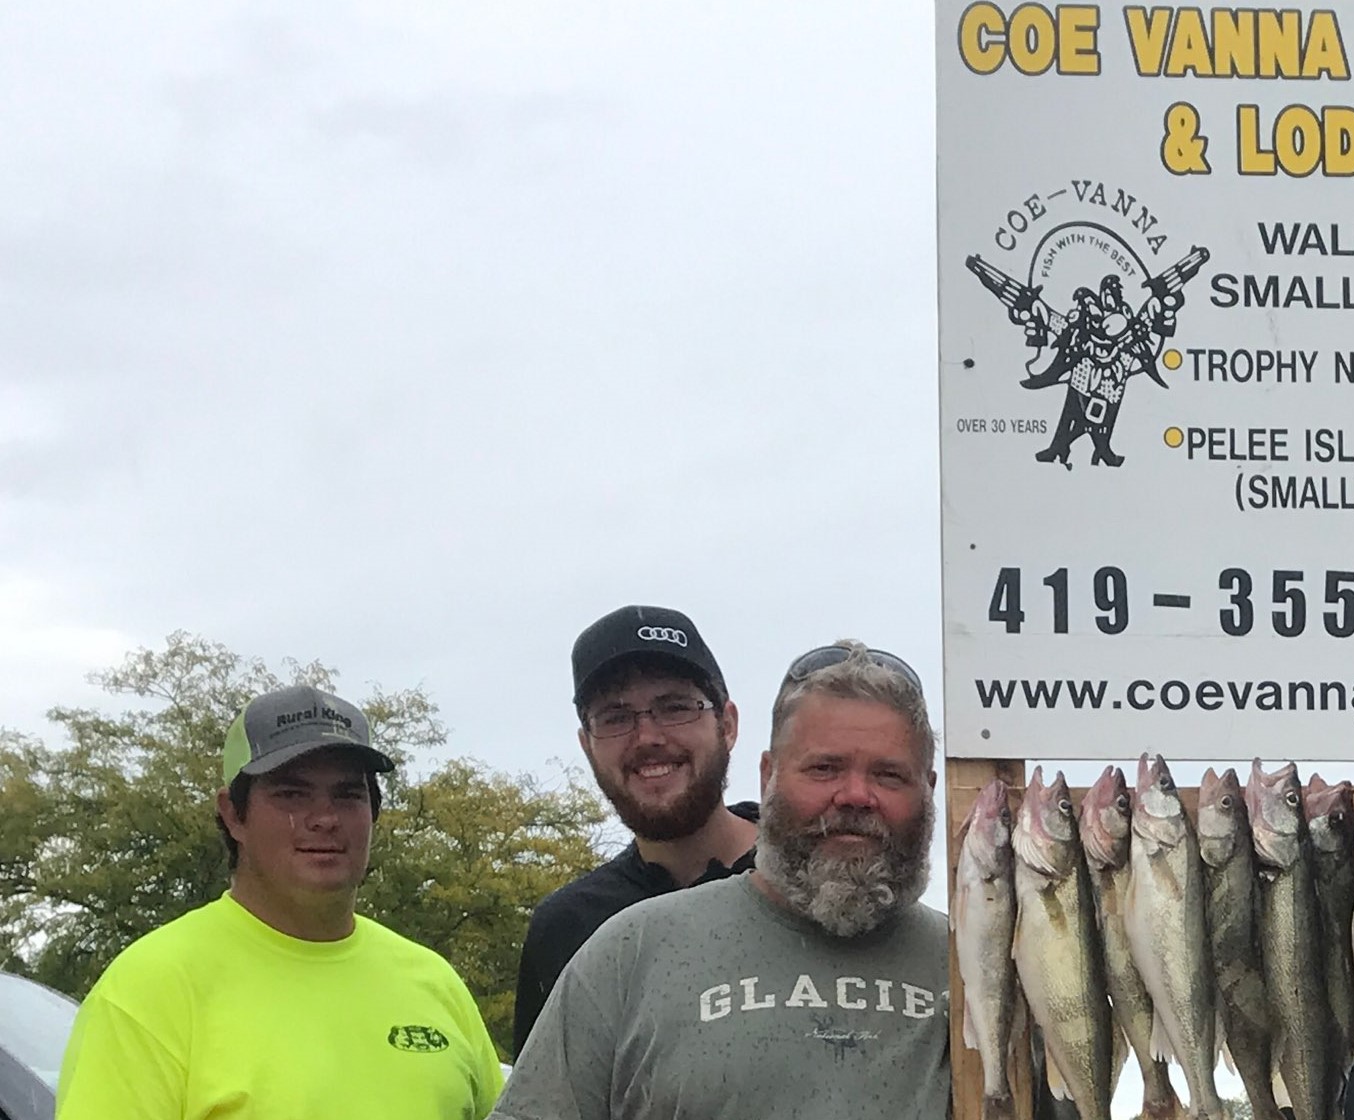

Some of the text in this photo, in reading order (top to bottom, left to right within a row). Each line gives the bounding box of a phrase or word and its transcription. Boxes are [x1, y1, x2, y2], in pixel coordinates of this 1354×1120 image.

[957, 1, 1102, 77] COE
[1122, 5, 1352, 82] VANNA
[1159, 101, 1212, 177] &
[994, 179, 1169, 256] COE-VANNA
[1041, 233, 1137, 278] FISH WITH THE BEST
[1186, 348, 1319, 384] TROPHY
[956, 418, 1047, 434] OVER 30 YEARS
[1187, 427, 1289, 462] PELEE
[276, 702, 353, 729] Rural King
[699, 973, 949, 1023] GLACIE
